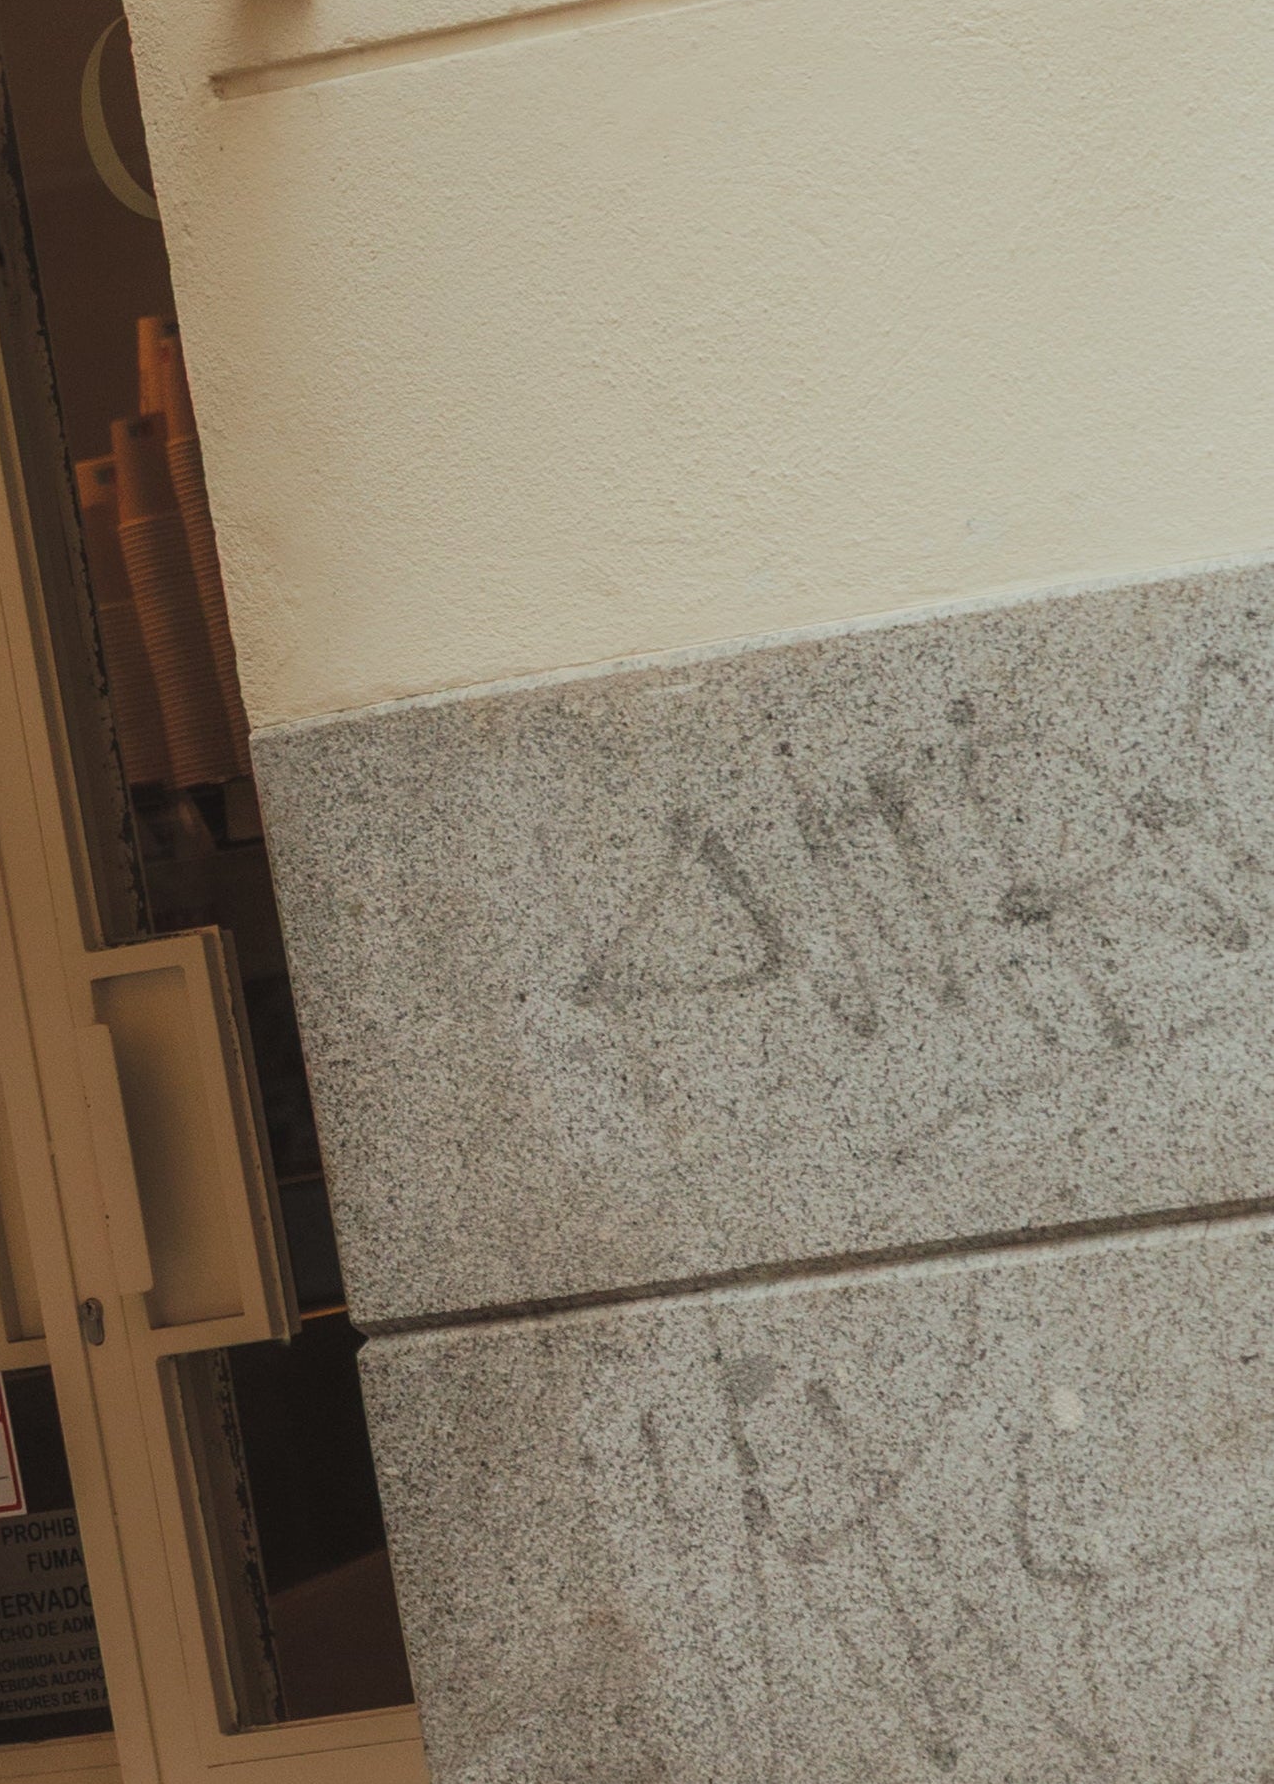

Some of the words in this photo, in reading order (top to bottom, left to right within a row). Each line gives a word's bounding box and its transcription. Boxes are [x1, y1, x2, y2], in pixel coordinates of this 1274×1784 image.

[1, 1517, 77, 1545] PROHIB
[37, 1620, 59, 1638] DE
[59, 1649, 77, 1665] LA
[62, 1690, 81, 1705] DE
[83, 1688, 99, 1703] 18
